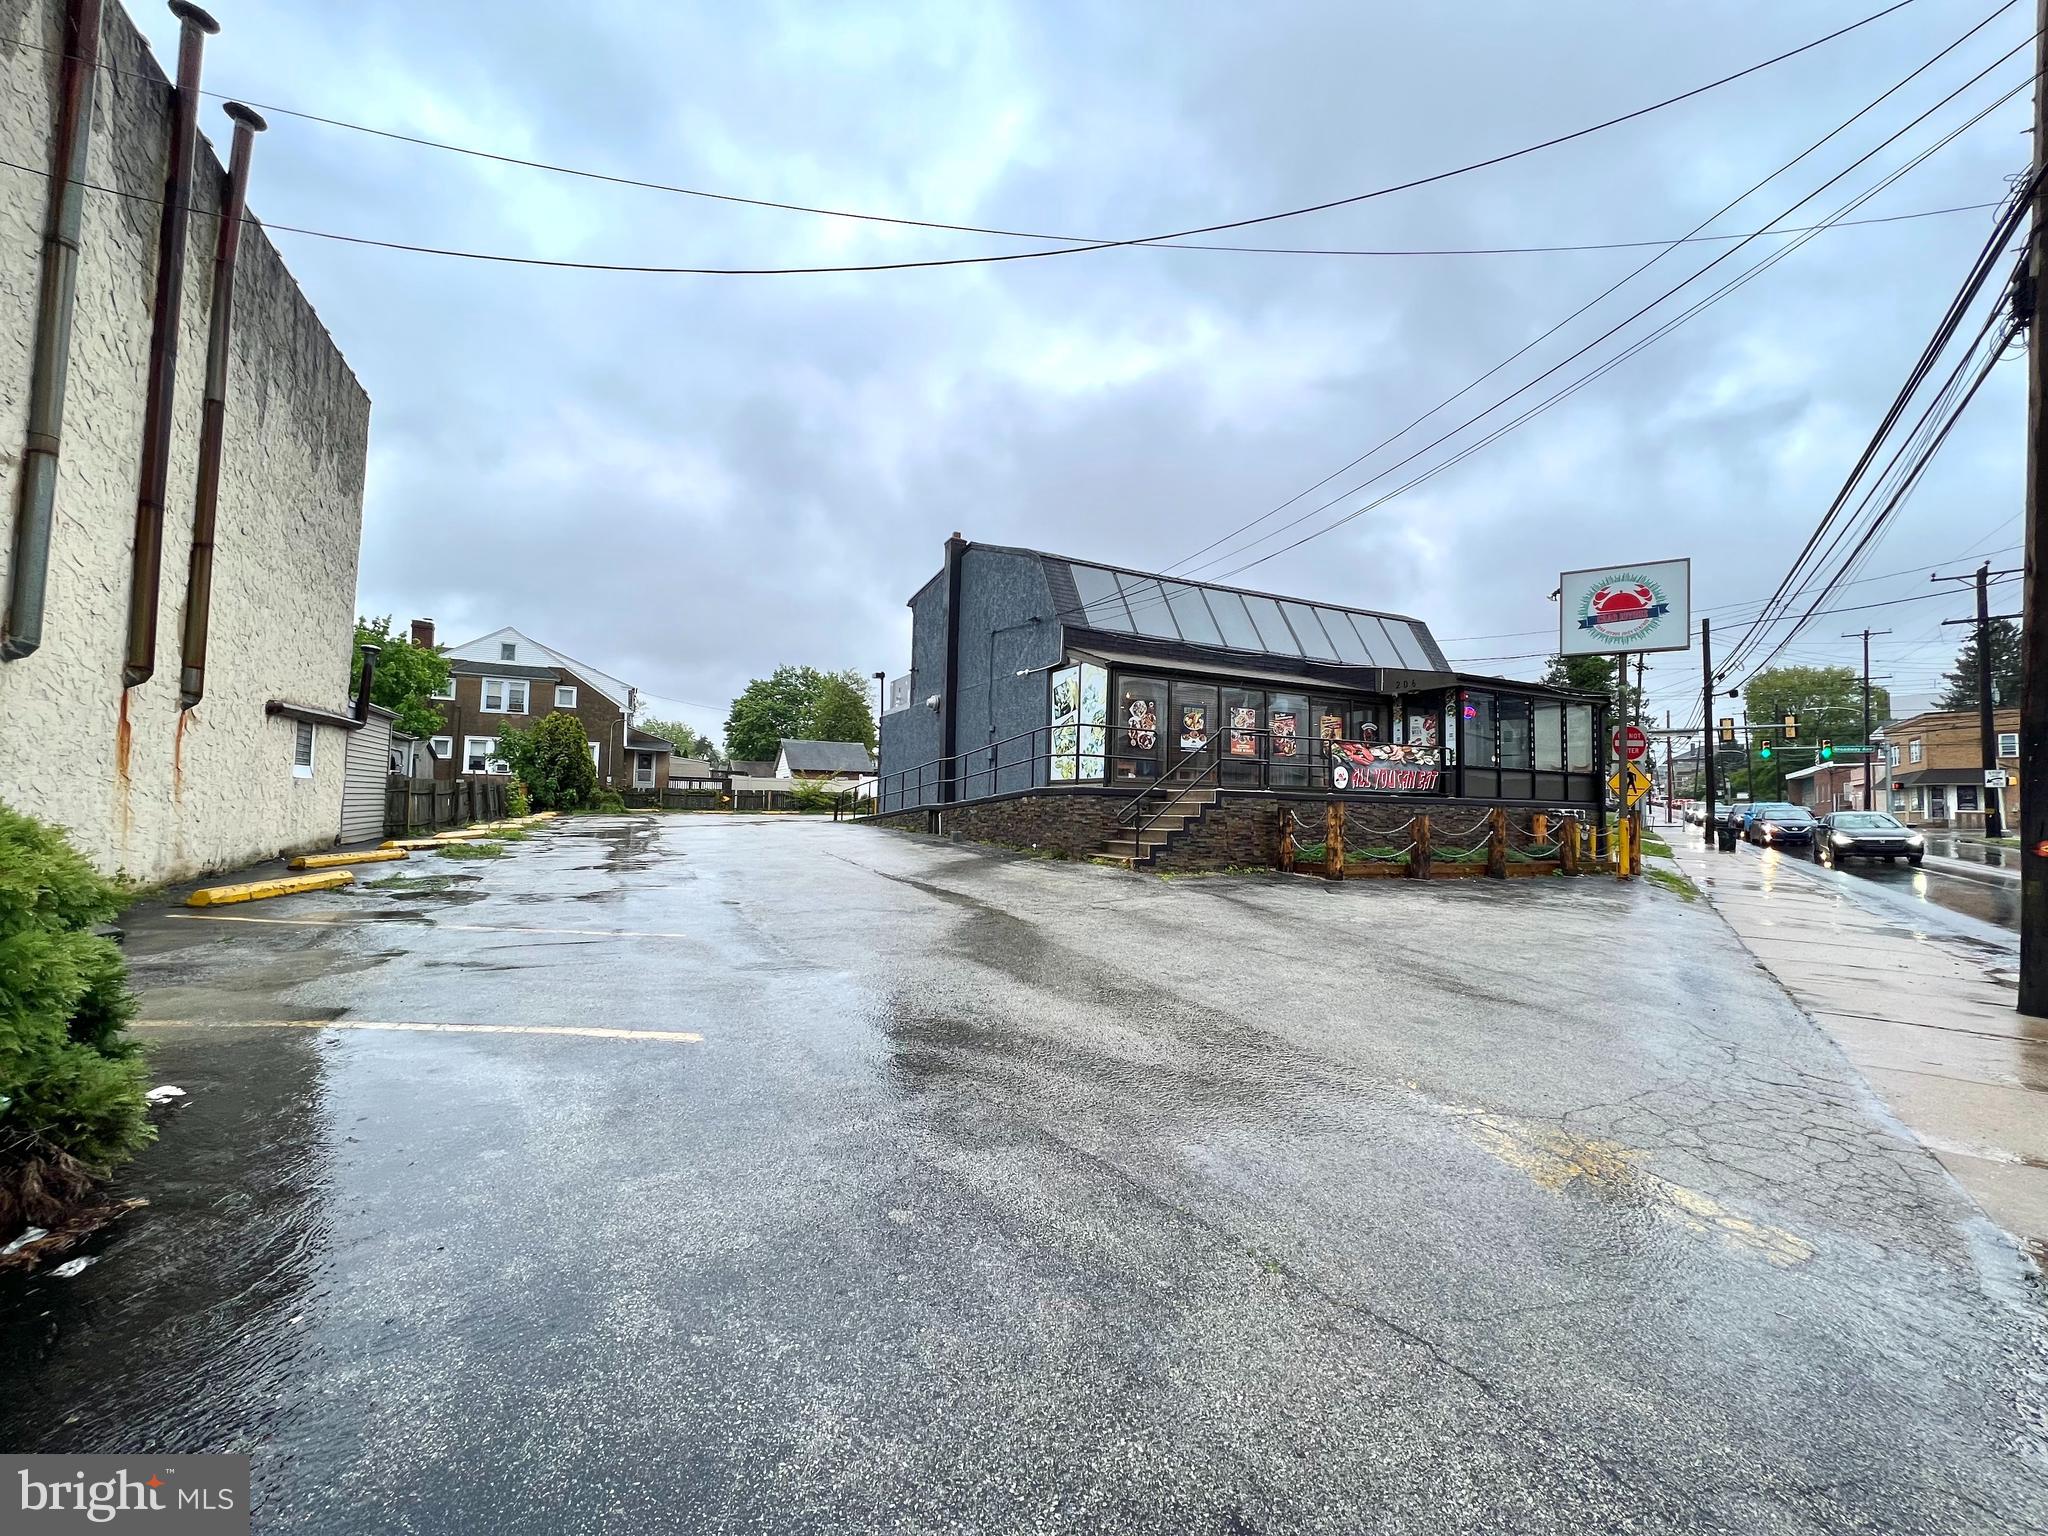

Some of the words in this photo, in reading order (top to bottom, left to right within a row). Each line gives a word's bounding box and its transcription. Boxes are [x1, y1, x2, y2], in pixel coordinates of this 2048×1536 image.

[1395, 680, 1416, 689] 206
[1352, 768, 1371, 789] ALL
[1374, 768, 1396, 790] YOU
[1398, 769, 1417, 790] CAN
[1417, 770, 1439, 790] EAT
